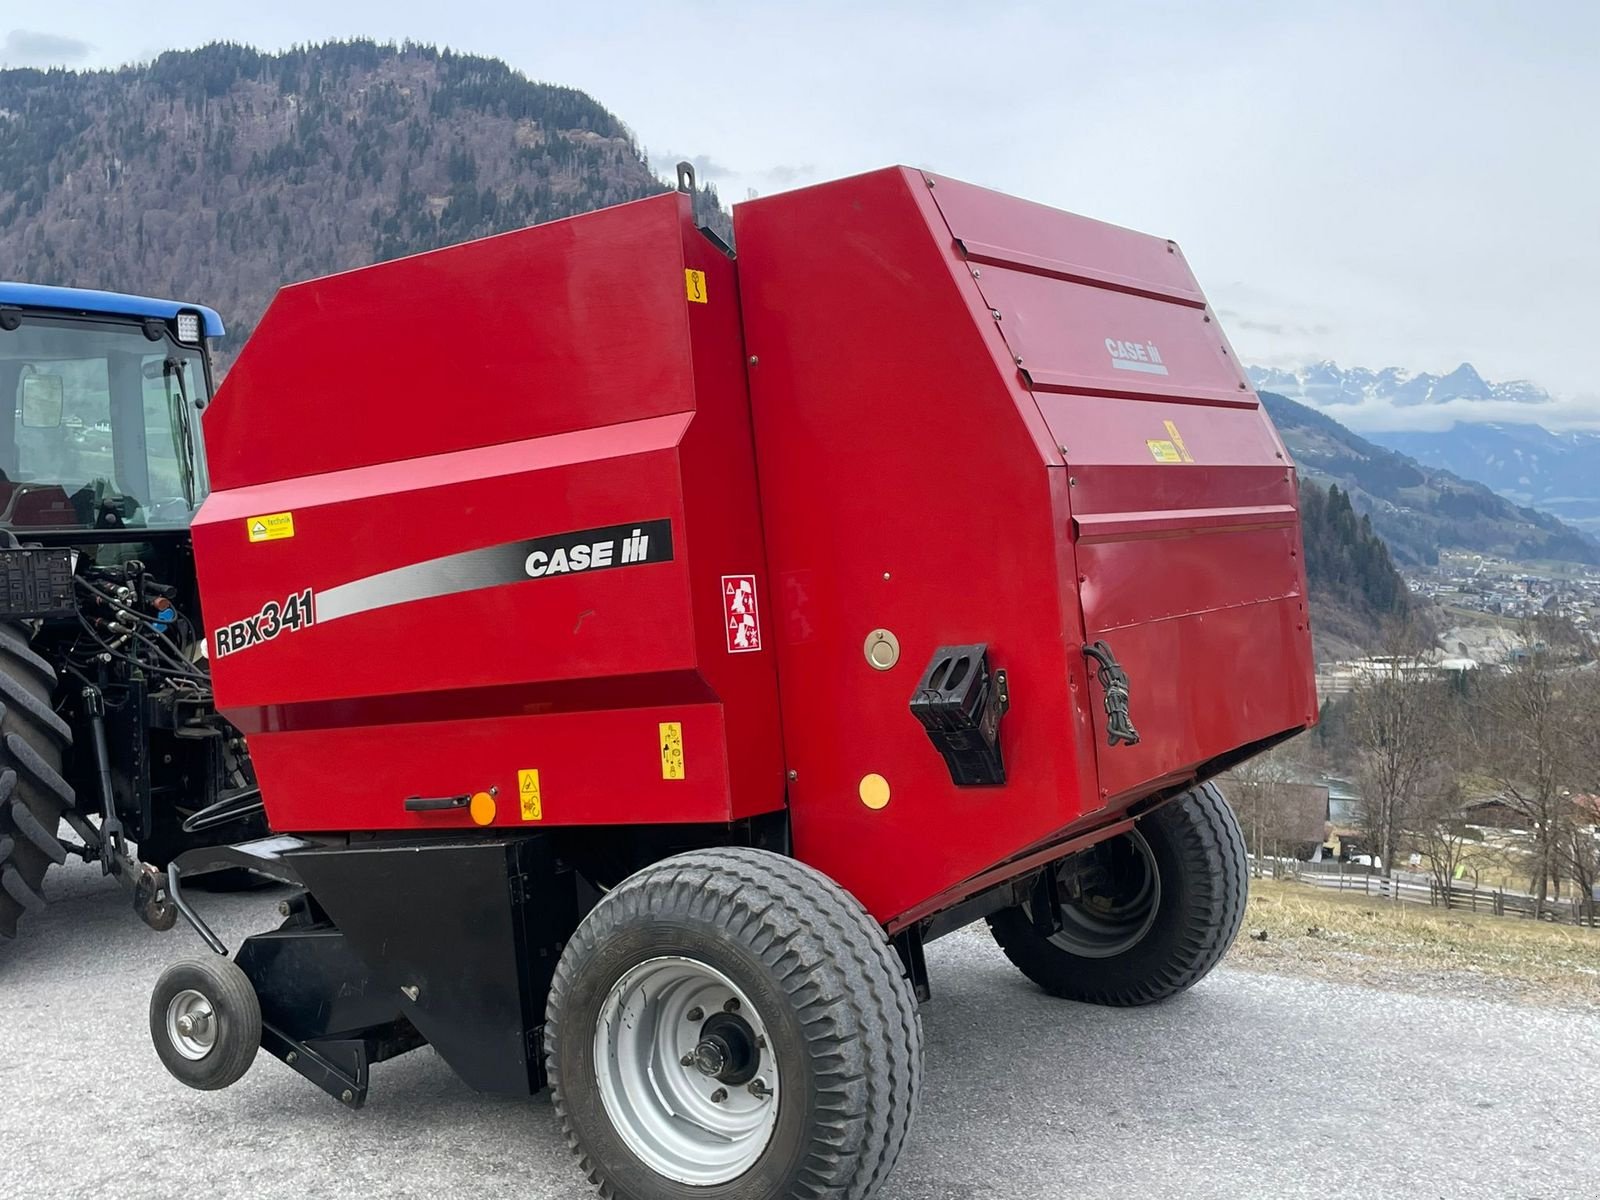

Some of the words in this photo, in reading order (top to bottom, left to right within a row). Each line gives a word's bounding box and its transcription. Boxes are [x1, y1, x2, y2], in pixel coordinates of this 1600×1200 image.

[1105, 338, 1148, 361] CASE
[525, 541, 613, 577] CASE
[214, 587, 314, 658] RBX341
